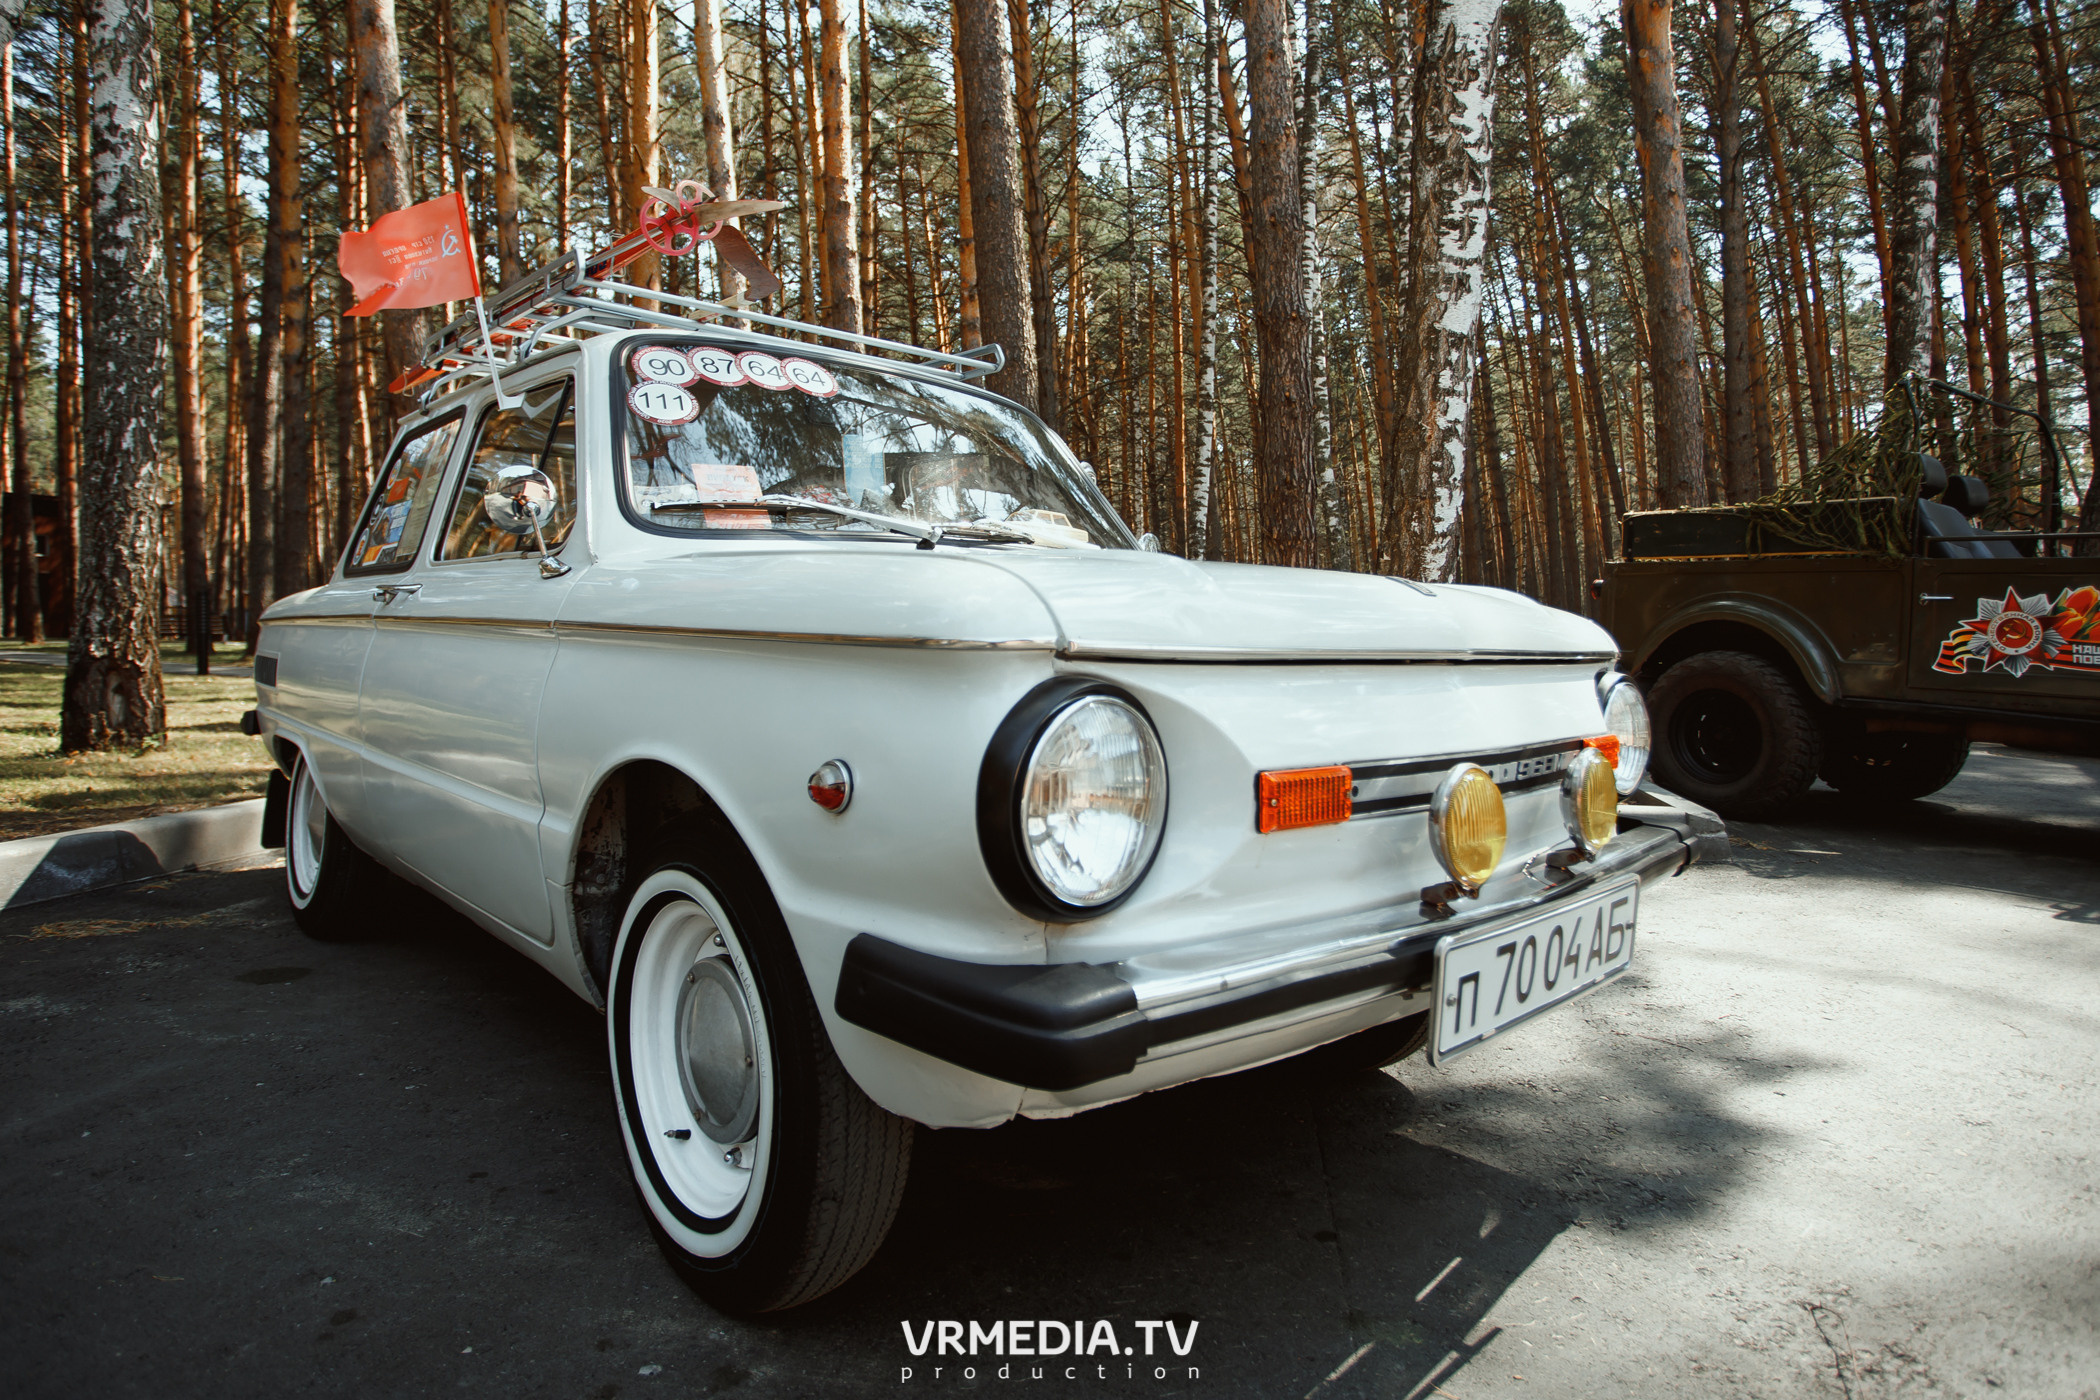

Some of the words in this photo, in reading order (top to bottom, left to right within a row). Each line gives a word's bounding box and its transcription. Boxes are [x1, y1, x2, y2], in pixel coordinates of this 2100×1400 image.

[648, 358, 686, 376] 90
[700, 357, 734, 375] 87
[748, 360, 785, 381] 64
[792, 367, 826, 387] 64
[638, 391, 684, 412] 111
